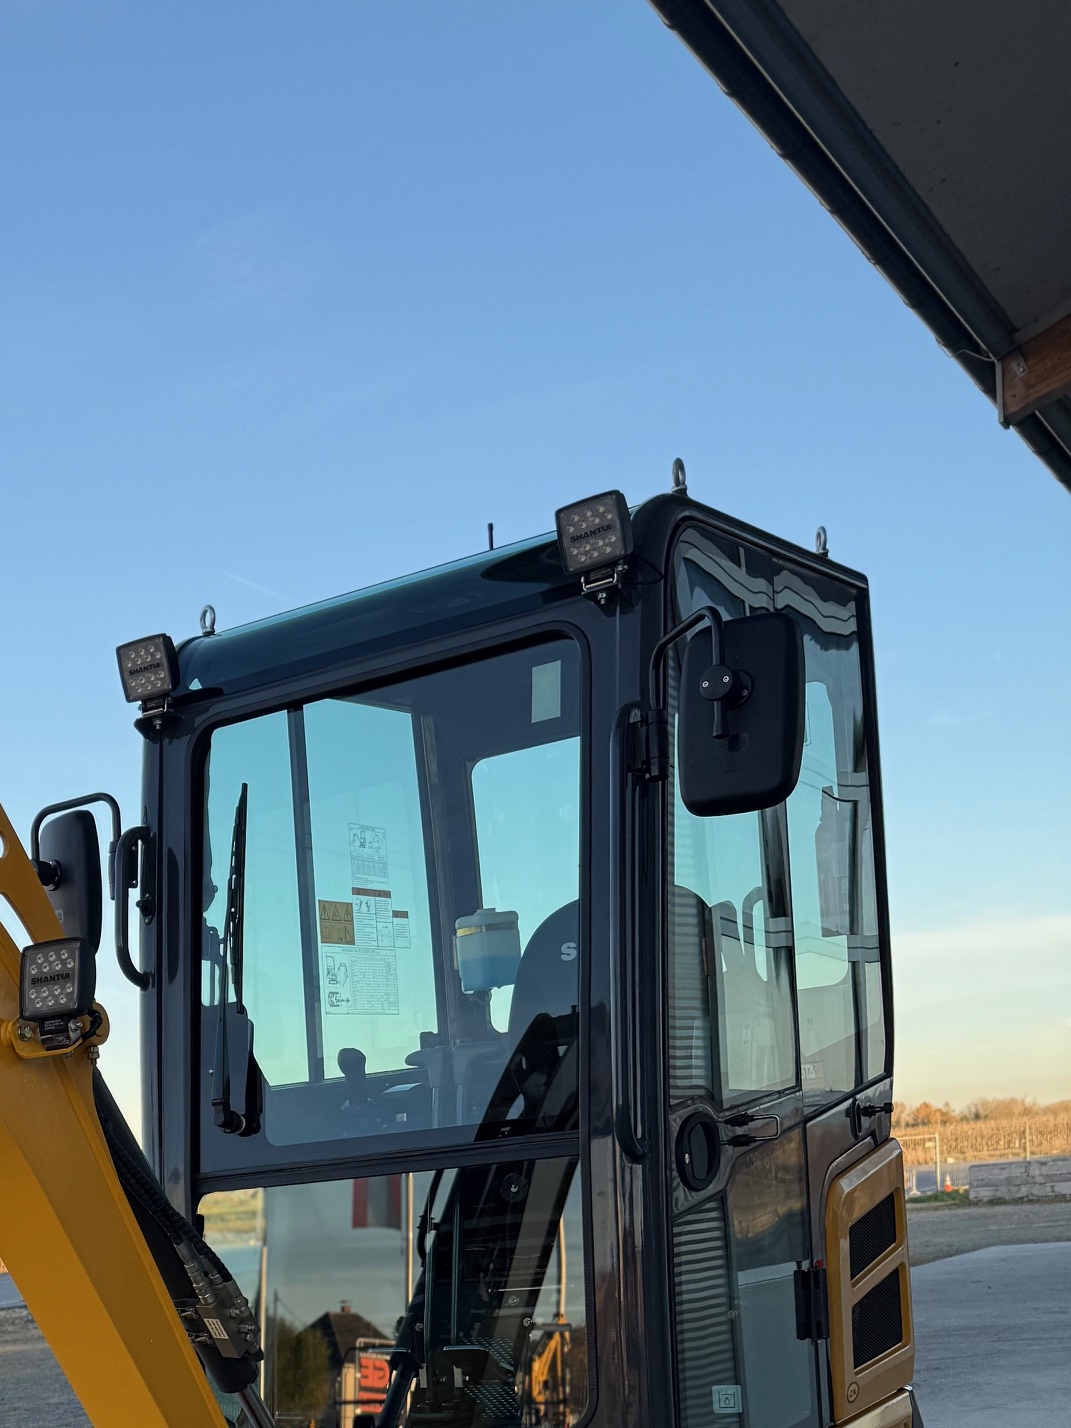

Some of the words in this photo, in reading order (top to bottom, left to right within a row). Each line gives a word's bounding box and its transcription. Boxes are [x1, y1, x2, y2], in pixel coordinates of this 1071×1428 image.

[569, 524, 612, 543] SHANTUI
[128, 662, 161, 676] SHANTUI
[30, 972, 71, 986] SHANTUI
